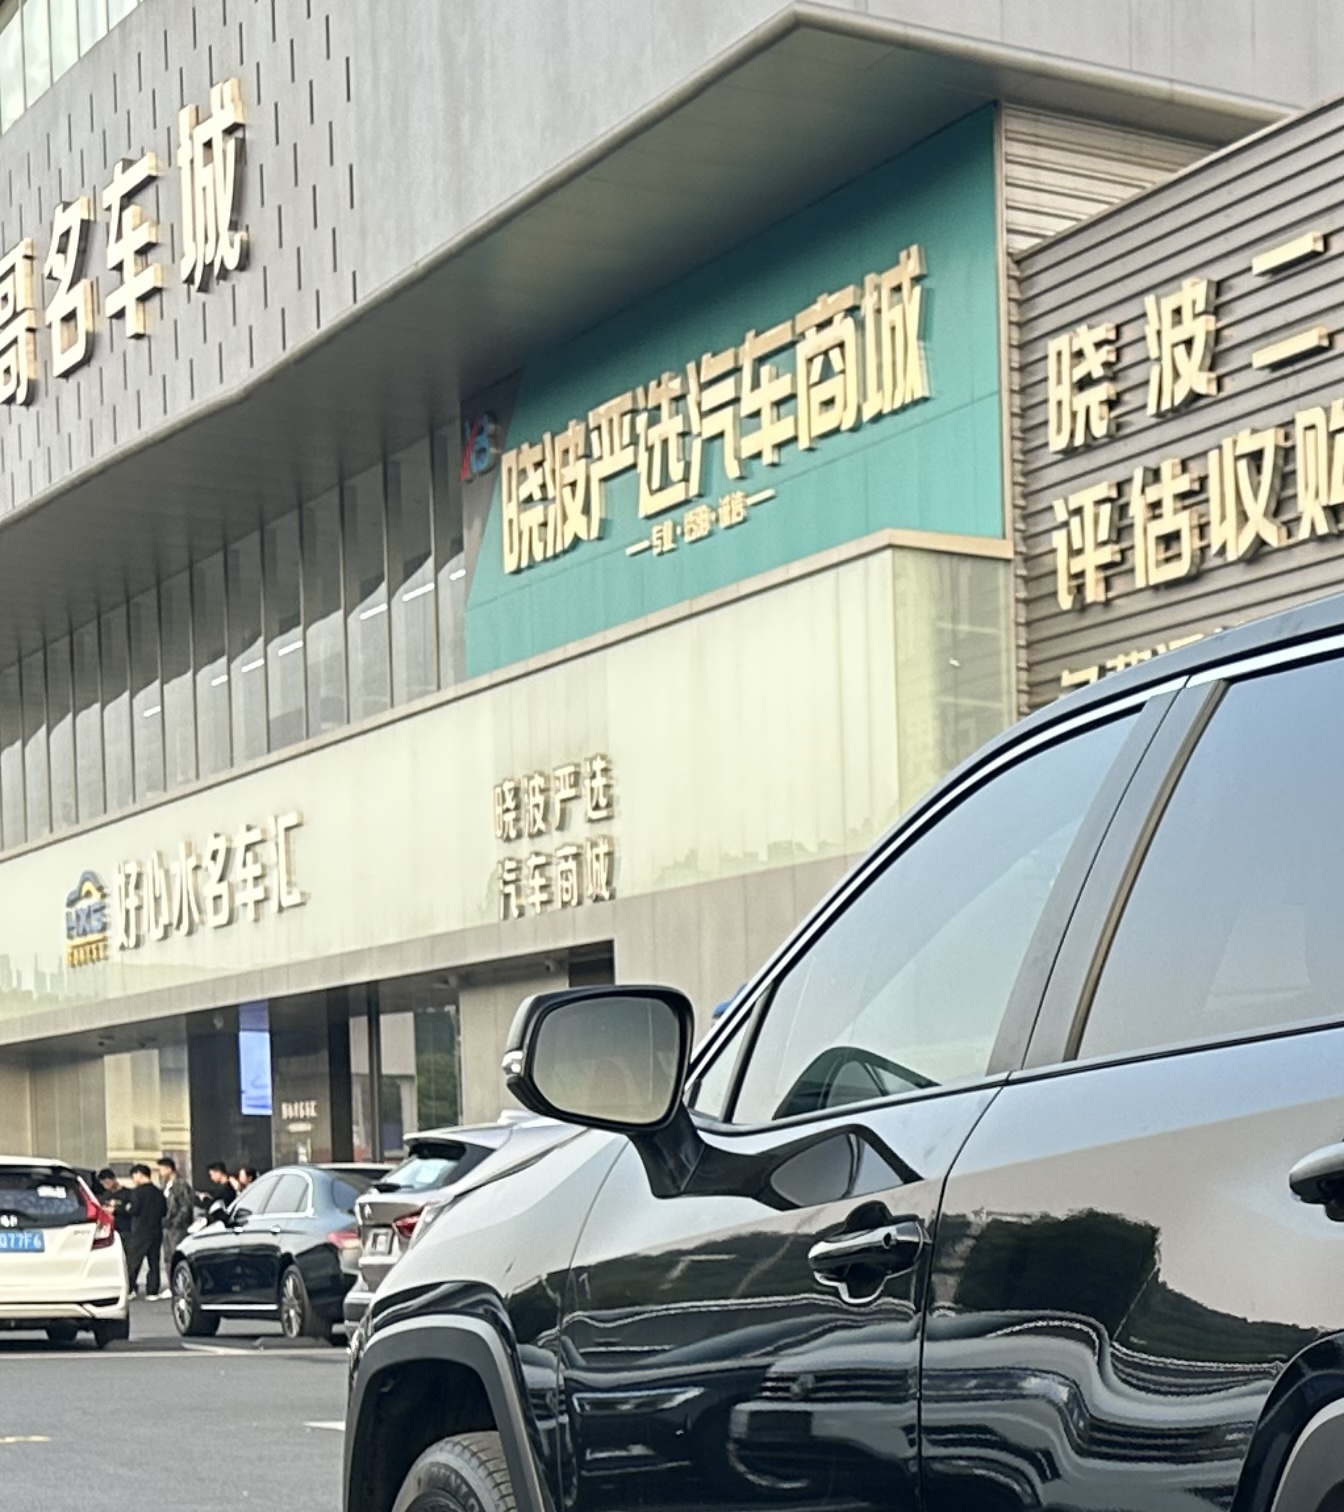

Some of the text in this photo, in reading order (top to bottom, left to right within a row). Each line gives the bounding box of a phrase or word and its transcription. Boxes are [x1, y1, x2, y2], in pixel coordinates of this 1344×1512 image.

[501, 243, 930, 573] 晓波严选汽车商城
[494, 753, 613, 842] 晓波严选
[114, 810, 307, 950] 好心水名车汇
[498, 835, 615, 920] 汽车商城
